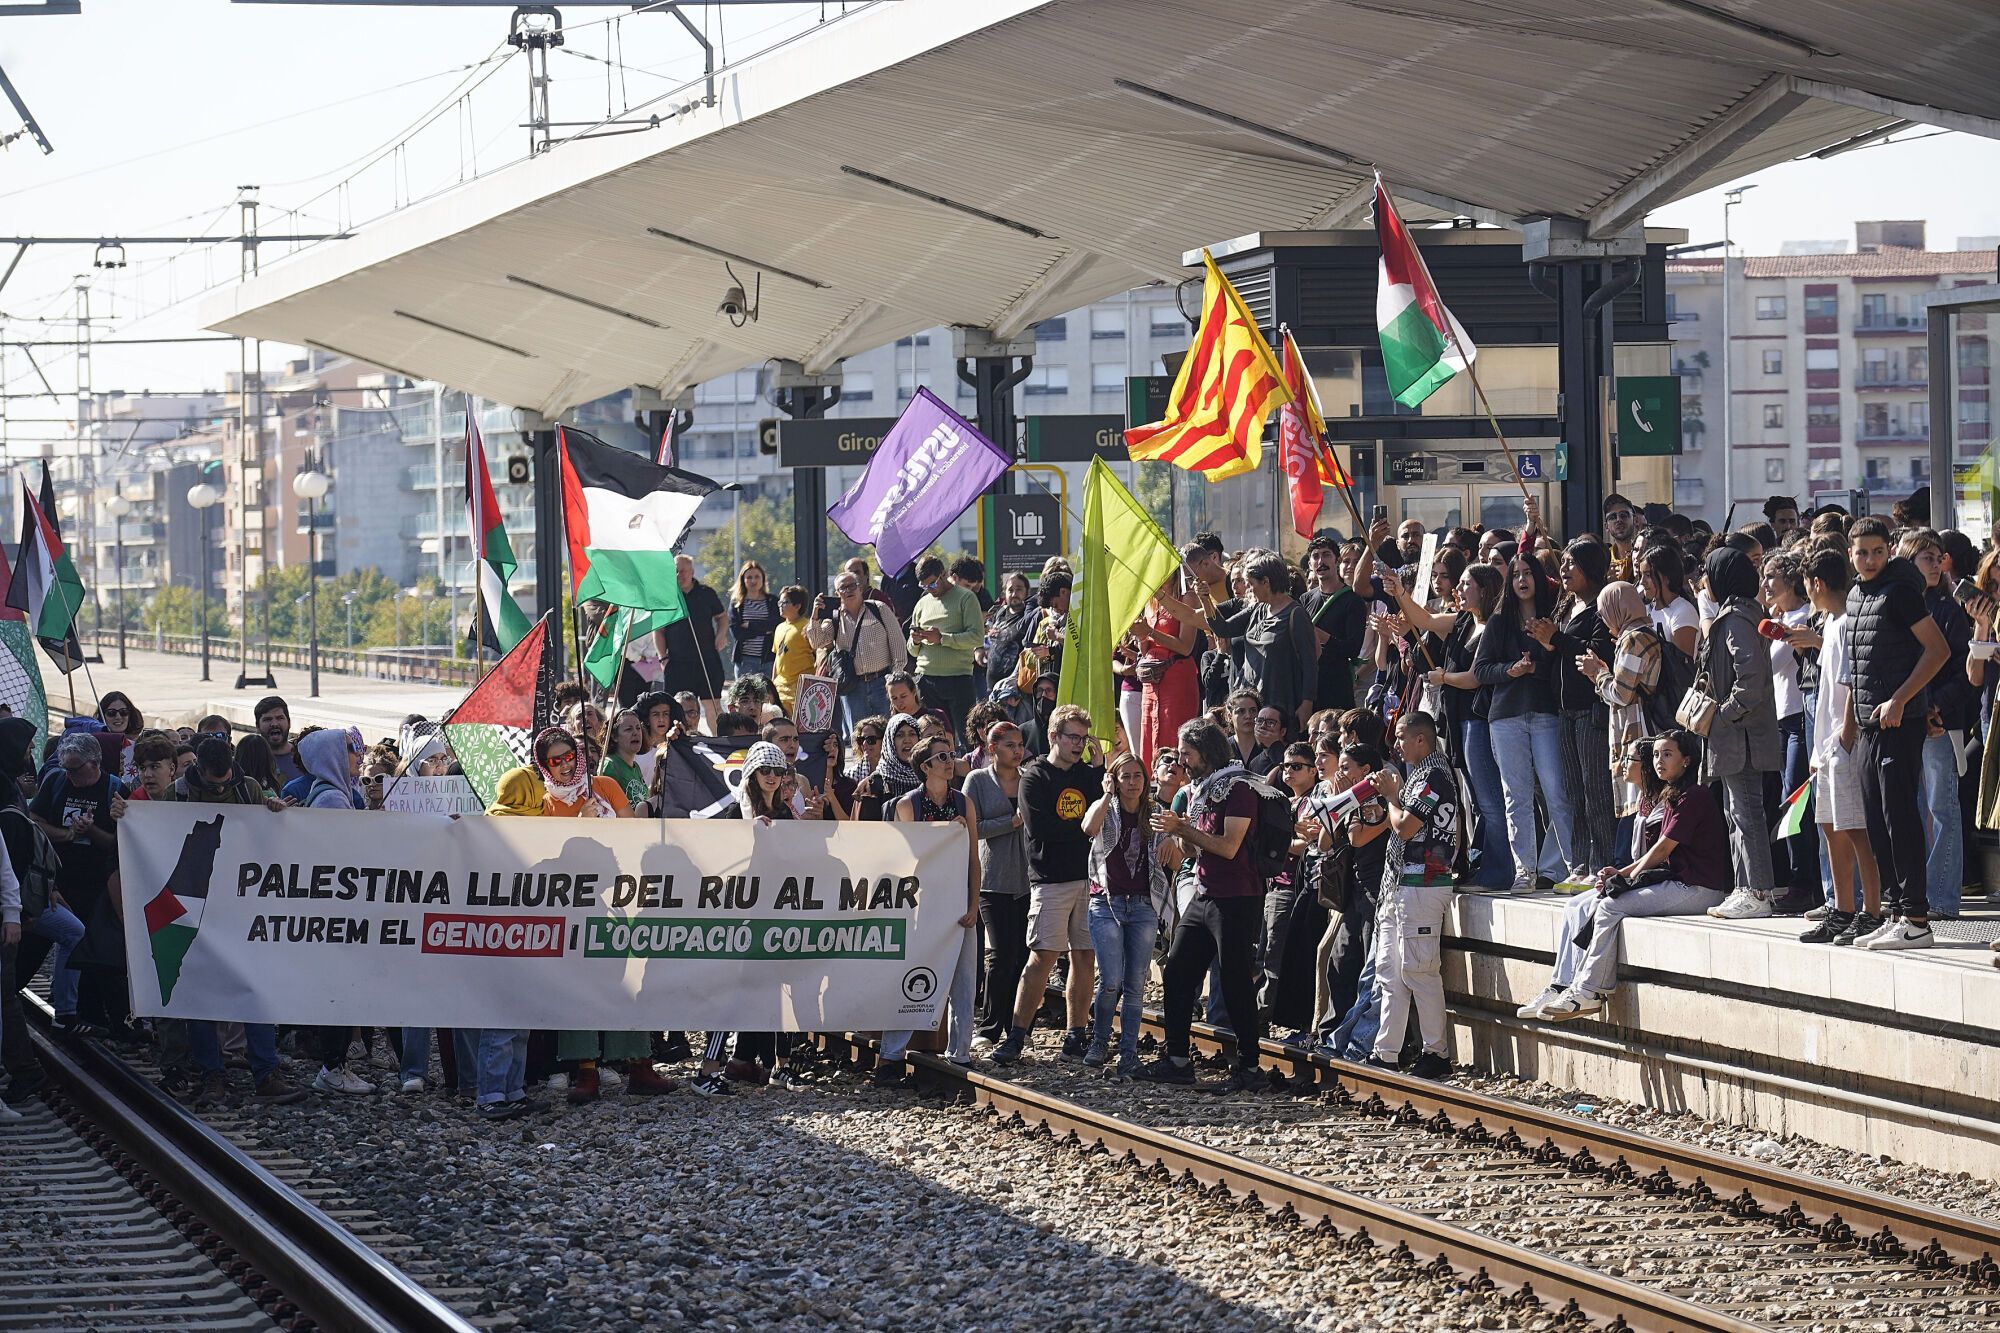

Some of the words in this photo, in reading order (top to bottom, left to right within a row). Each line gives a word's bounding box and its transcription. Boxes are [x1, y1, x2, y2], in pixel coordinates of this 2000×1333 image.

[1096, 428, 1127, 447] Gir
[414, 780, 438, 794] PARA
[425, 797, 444, 813] PAZ
[446, 797, 453, 813] Y
[455, 797, 483, 813] NUNC
[237, 862, 451, 905] PALESTINA
[466, 872, 598, 908] LLIURE
[611, 874, 683, 909] DEL
[697, 875, 761, 910] RIU
[773, 876, 824, 911] AL
[838, 875, 920, 911] MAR
[247, 914, 369, 944] ATUREM
[379, 919, 416, 945] EL
[426, 921, 560, 951] GENOCIDI
[569, 923, 580, 950] I
[762, 924, 901, 953] COLONIAL
